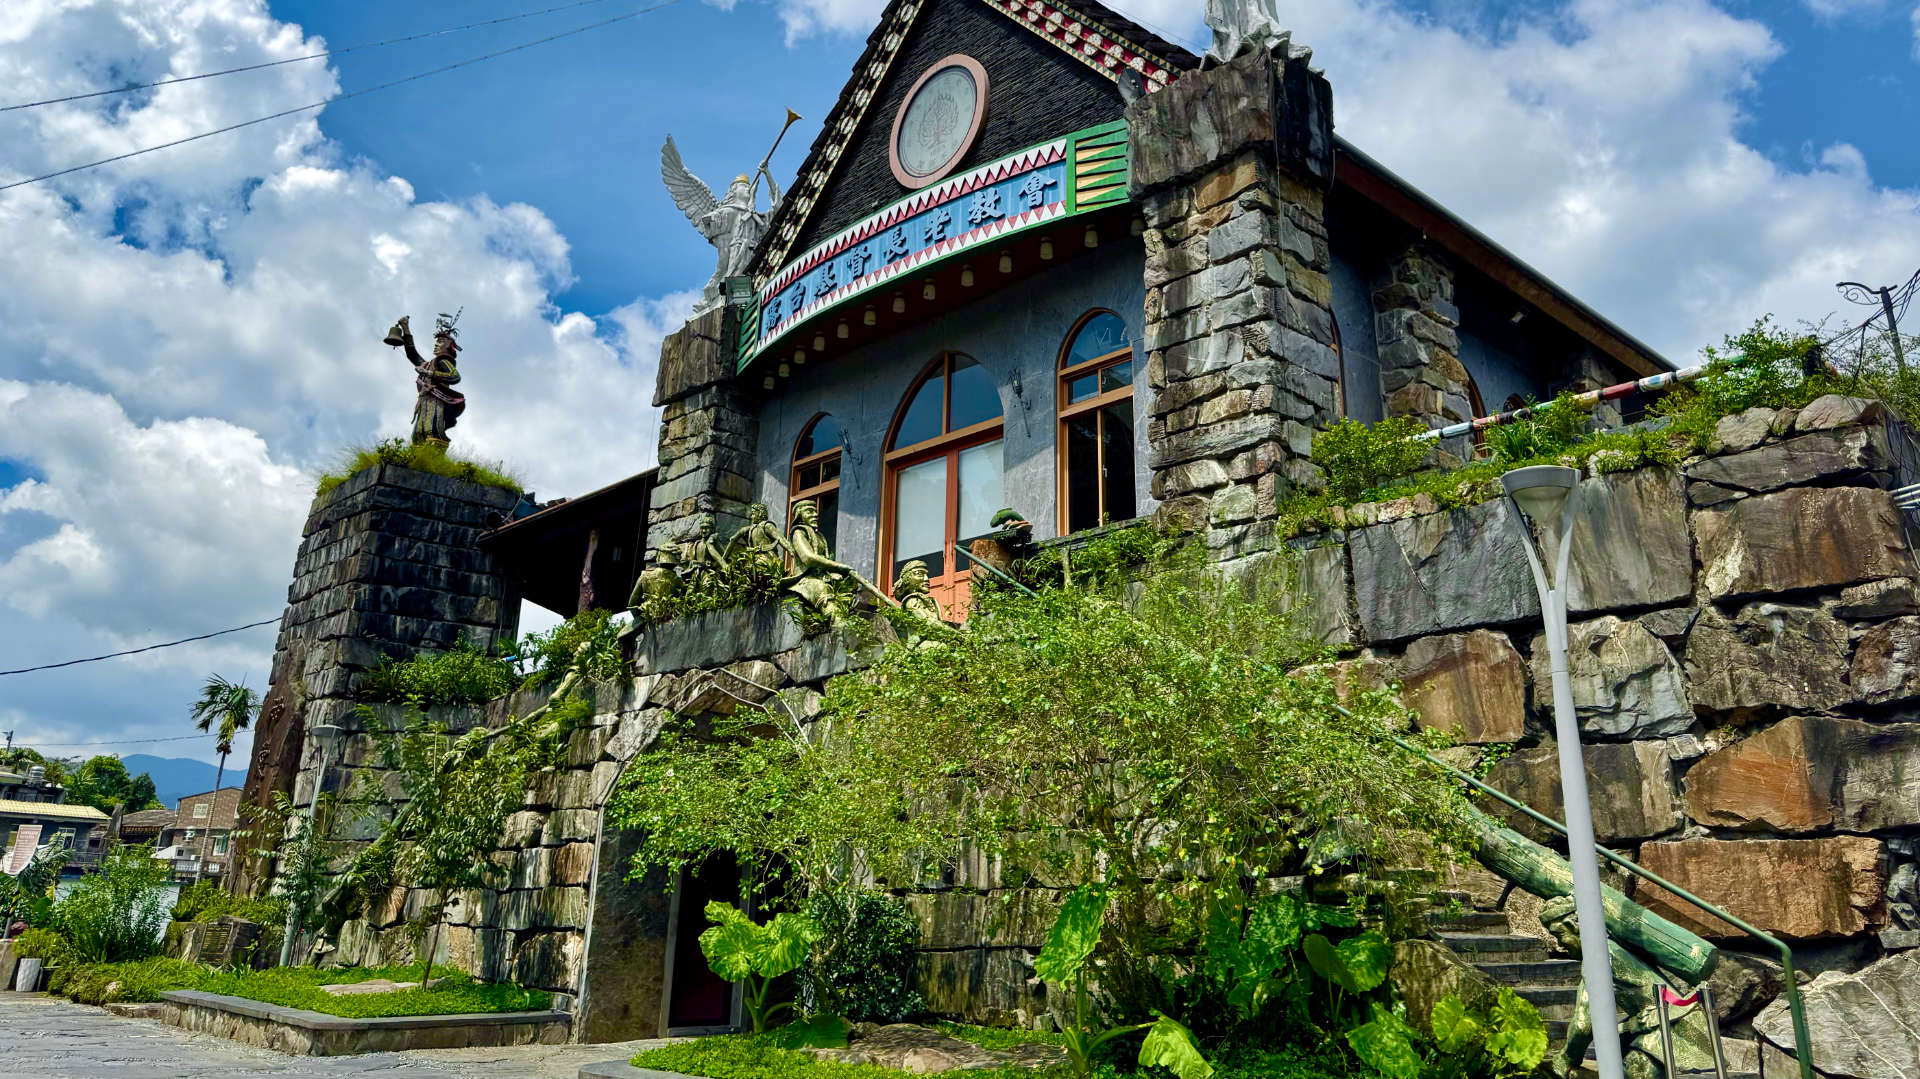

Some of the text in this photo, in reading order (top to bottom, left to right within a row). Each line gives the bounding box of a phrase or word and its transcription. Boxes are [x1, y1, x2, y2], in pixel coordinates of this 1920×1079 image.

[765, 171, 1057, 331] 霧台基督長老教會
